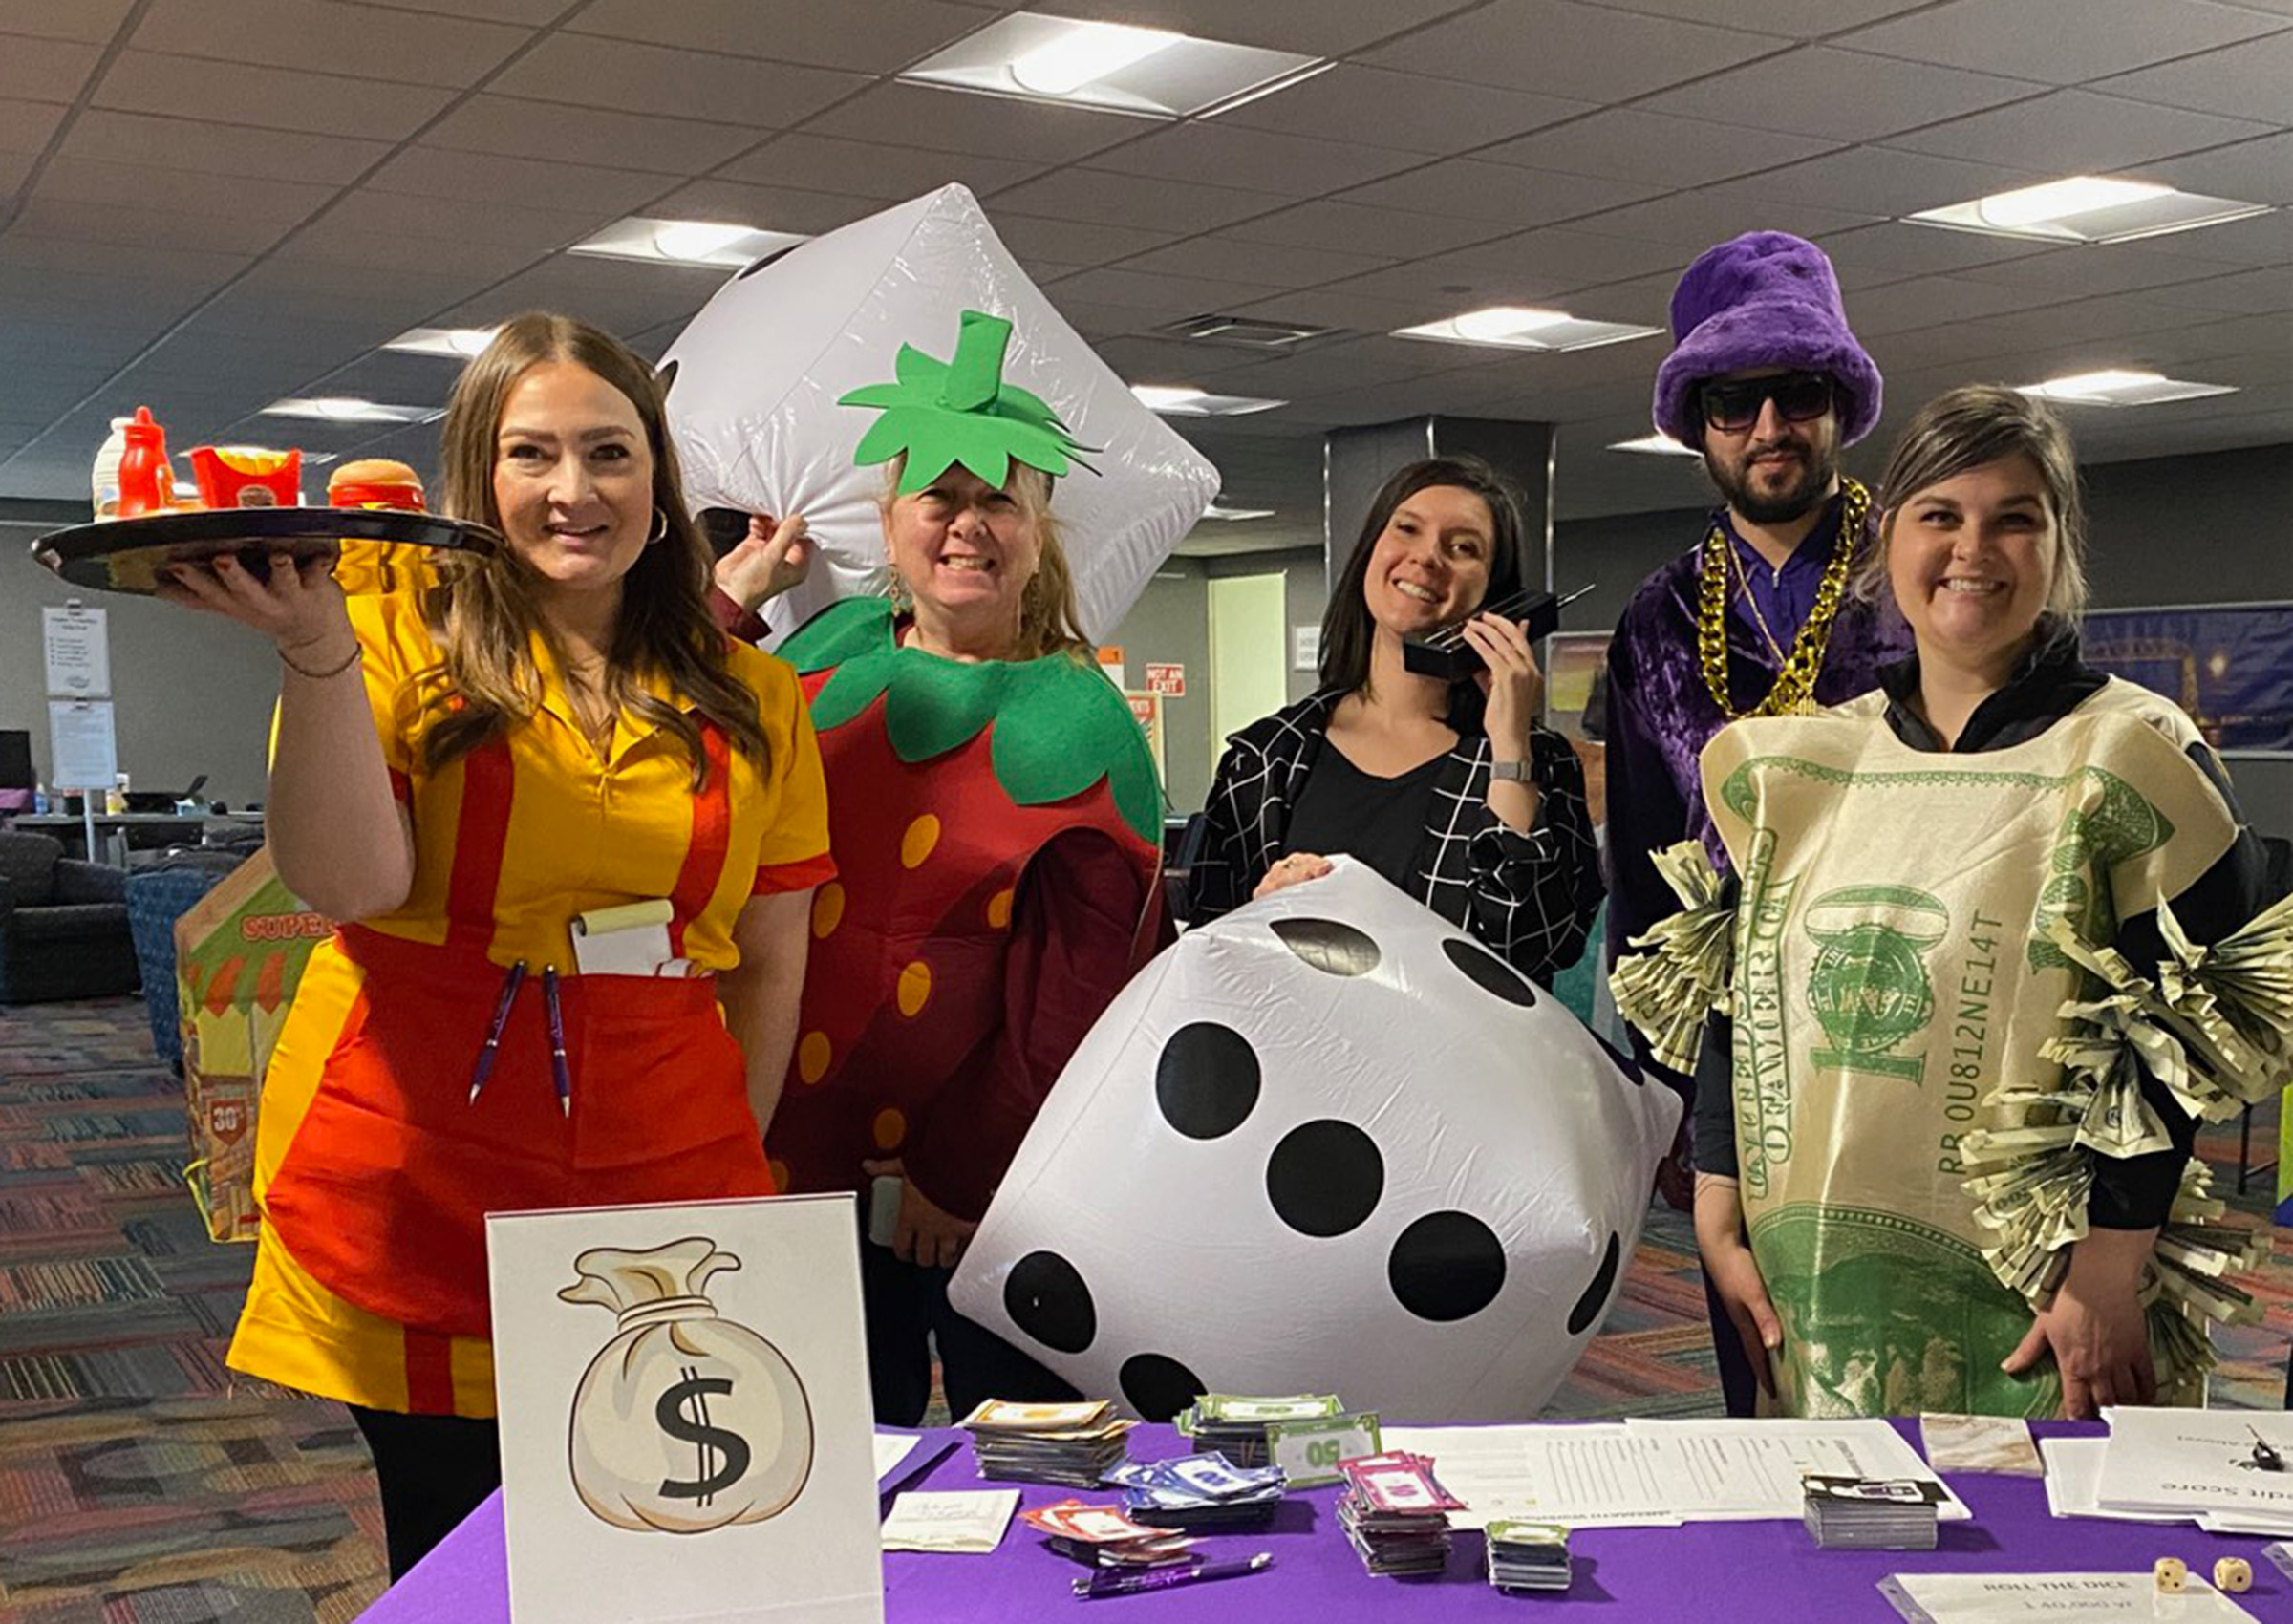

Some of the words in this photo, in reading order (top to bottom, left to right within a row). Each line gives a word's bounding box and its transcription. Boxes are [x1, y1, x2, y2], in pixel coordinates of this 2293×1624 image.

[2161, 1483, 2239, 1496] Score
[1983, 1583, 2036, 1592] ROLL
[2038, 1581, 2079, 1591] THE
[2082, 1581, 2132, 1590] DICE
